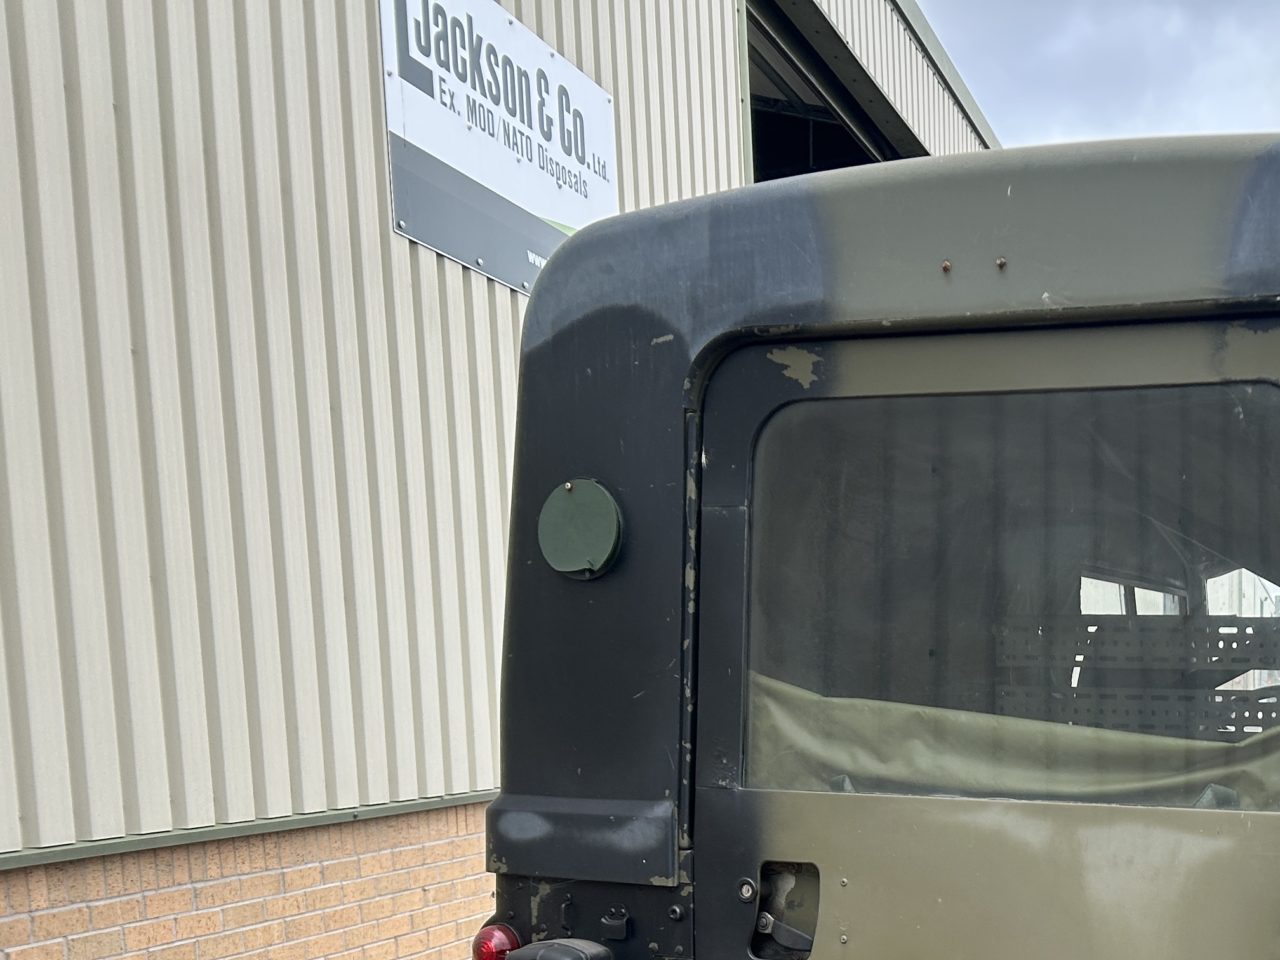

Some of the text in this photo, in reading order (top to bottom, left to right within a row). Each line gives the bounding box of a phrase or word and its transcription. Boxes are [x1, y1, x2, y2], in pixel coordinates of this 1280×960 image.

[413, 0, 533, 131] Jackson
[536, 67, 554, 142] &
[557, 83, 590, 170] Co.
[537, 142, 588, 199] Disposals
